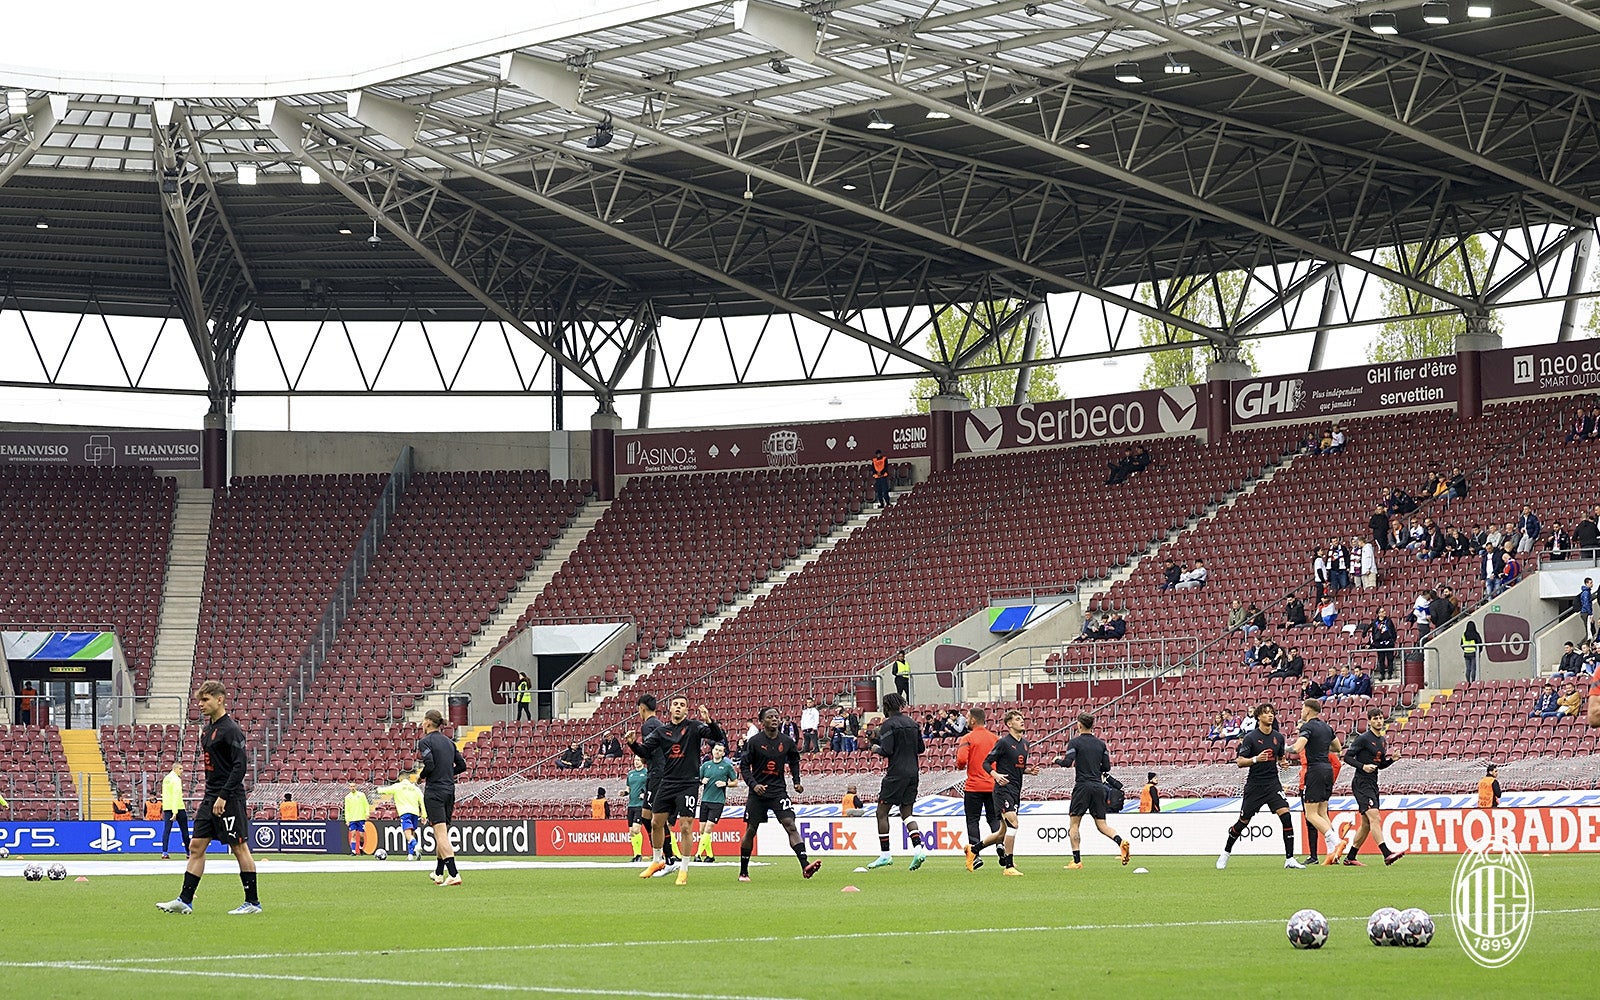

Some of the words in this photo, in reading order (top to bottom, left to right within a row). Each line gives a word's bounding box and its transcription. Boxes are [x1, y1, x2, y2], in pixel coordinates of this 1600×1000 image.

[1367, 368, 1390, 384] GHI
[1394, 366, 1416, 381] fier
[1419, 361, 1456, 378] d'être
[1540, 355, 1577, 376] neo
[1540, 376, 1569, 389] SMART
[1235, 380, 1295, 419] GHI
[1380, 386, 1444, 405] servettien
[1016, 398, 1144, 444] Serbeco
[893, 427, 926, 442] CASINO
[125, 444, 199, 455] LEMANVISIO
[685, 796, 696, 807] 10
[223, 816, 236, 831] 17
[1382, 809, 1600, 853] GATORADE
[280, 828, 327, 846] RESPECT
[568, 832, 600, 843] TURKISH
[602, 832, 633, 843] AIRLINE
[800, 822, 857, 850] FedEx
[1037, 827, 1071, 843] opp
[1130, 826, 1174, 843] oppo
